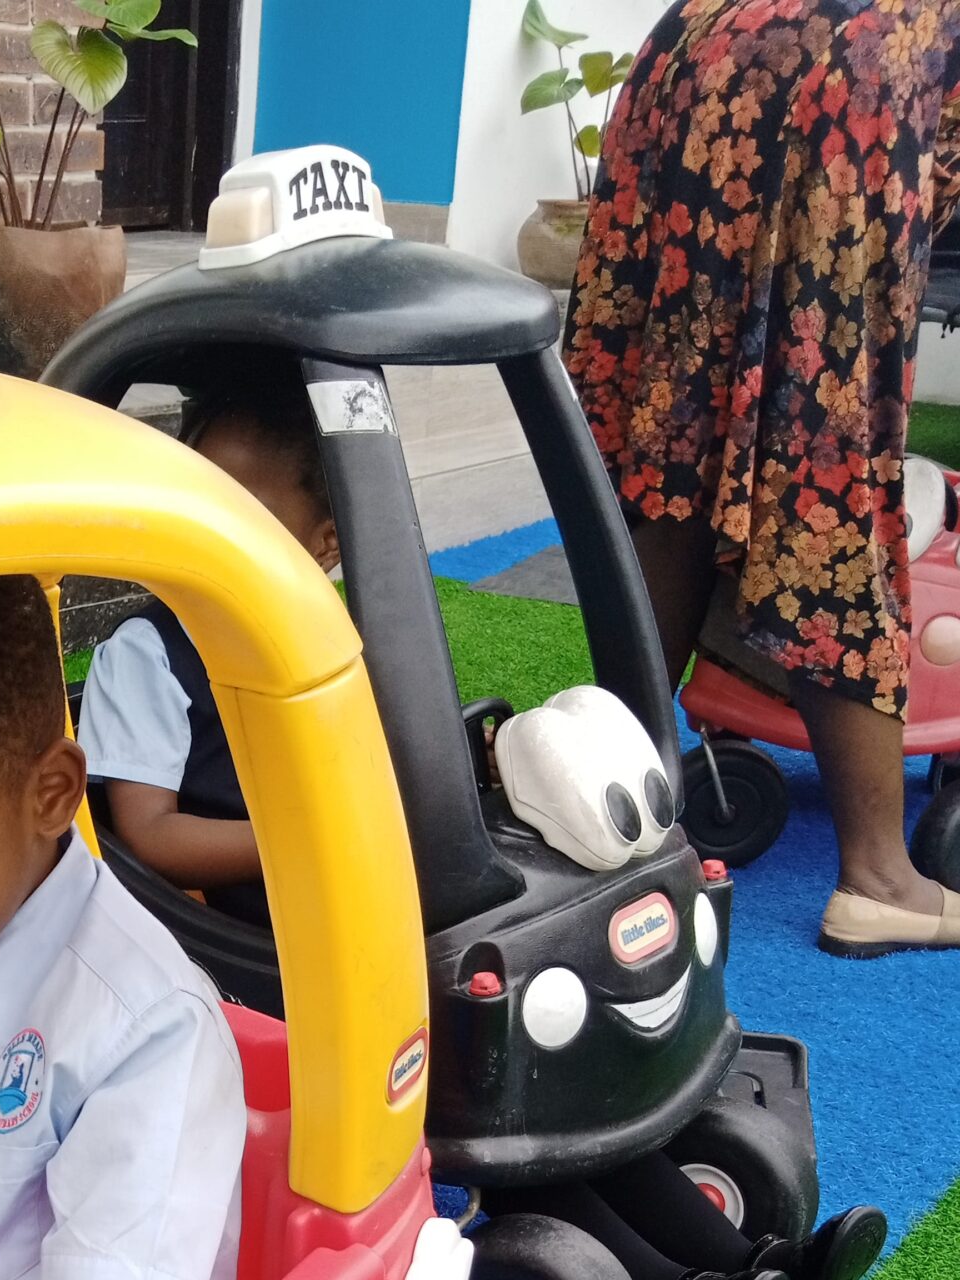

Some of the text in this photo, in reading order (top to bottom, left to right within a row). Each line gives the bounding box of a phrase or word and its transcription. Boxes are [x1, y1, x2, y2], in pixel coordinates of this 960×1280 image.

[289, 159, 370, 221] TAXI
[621, 913, 665, 946] little tikes
[19, 1091, 39, 1122] SCHOOL
